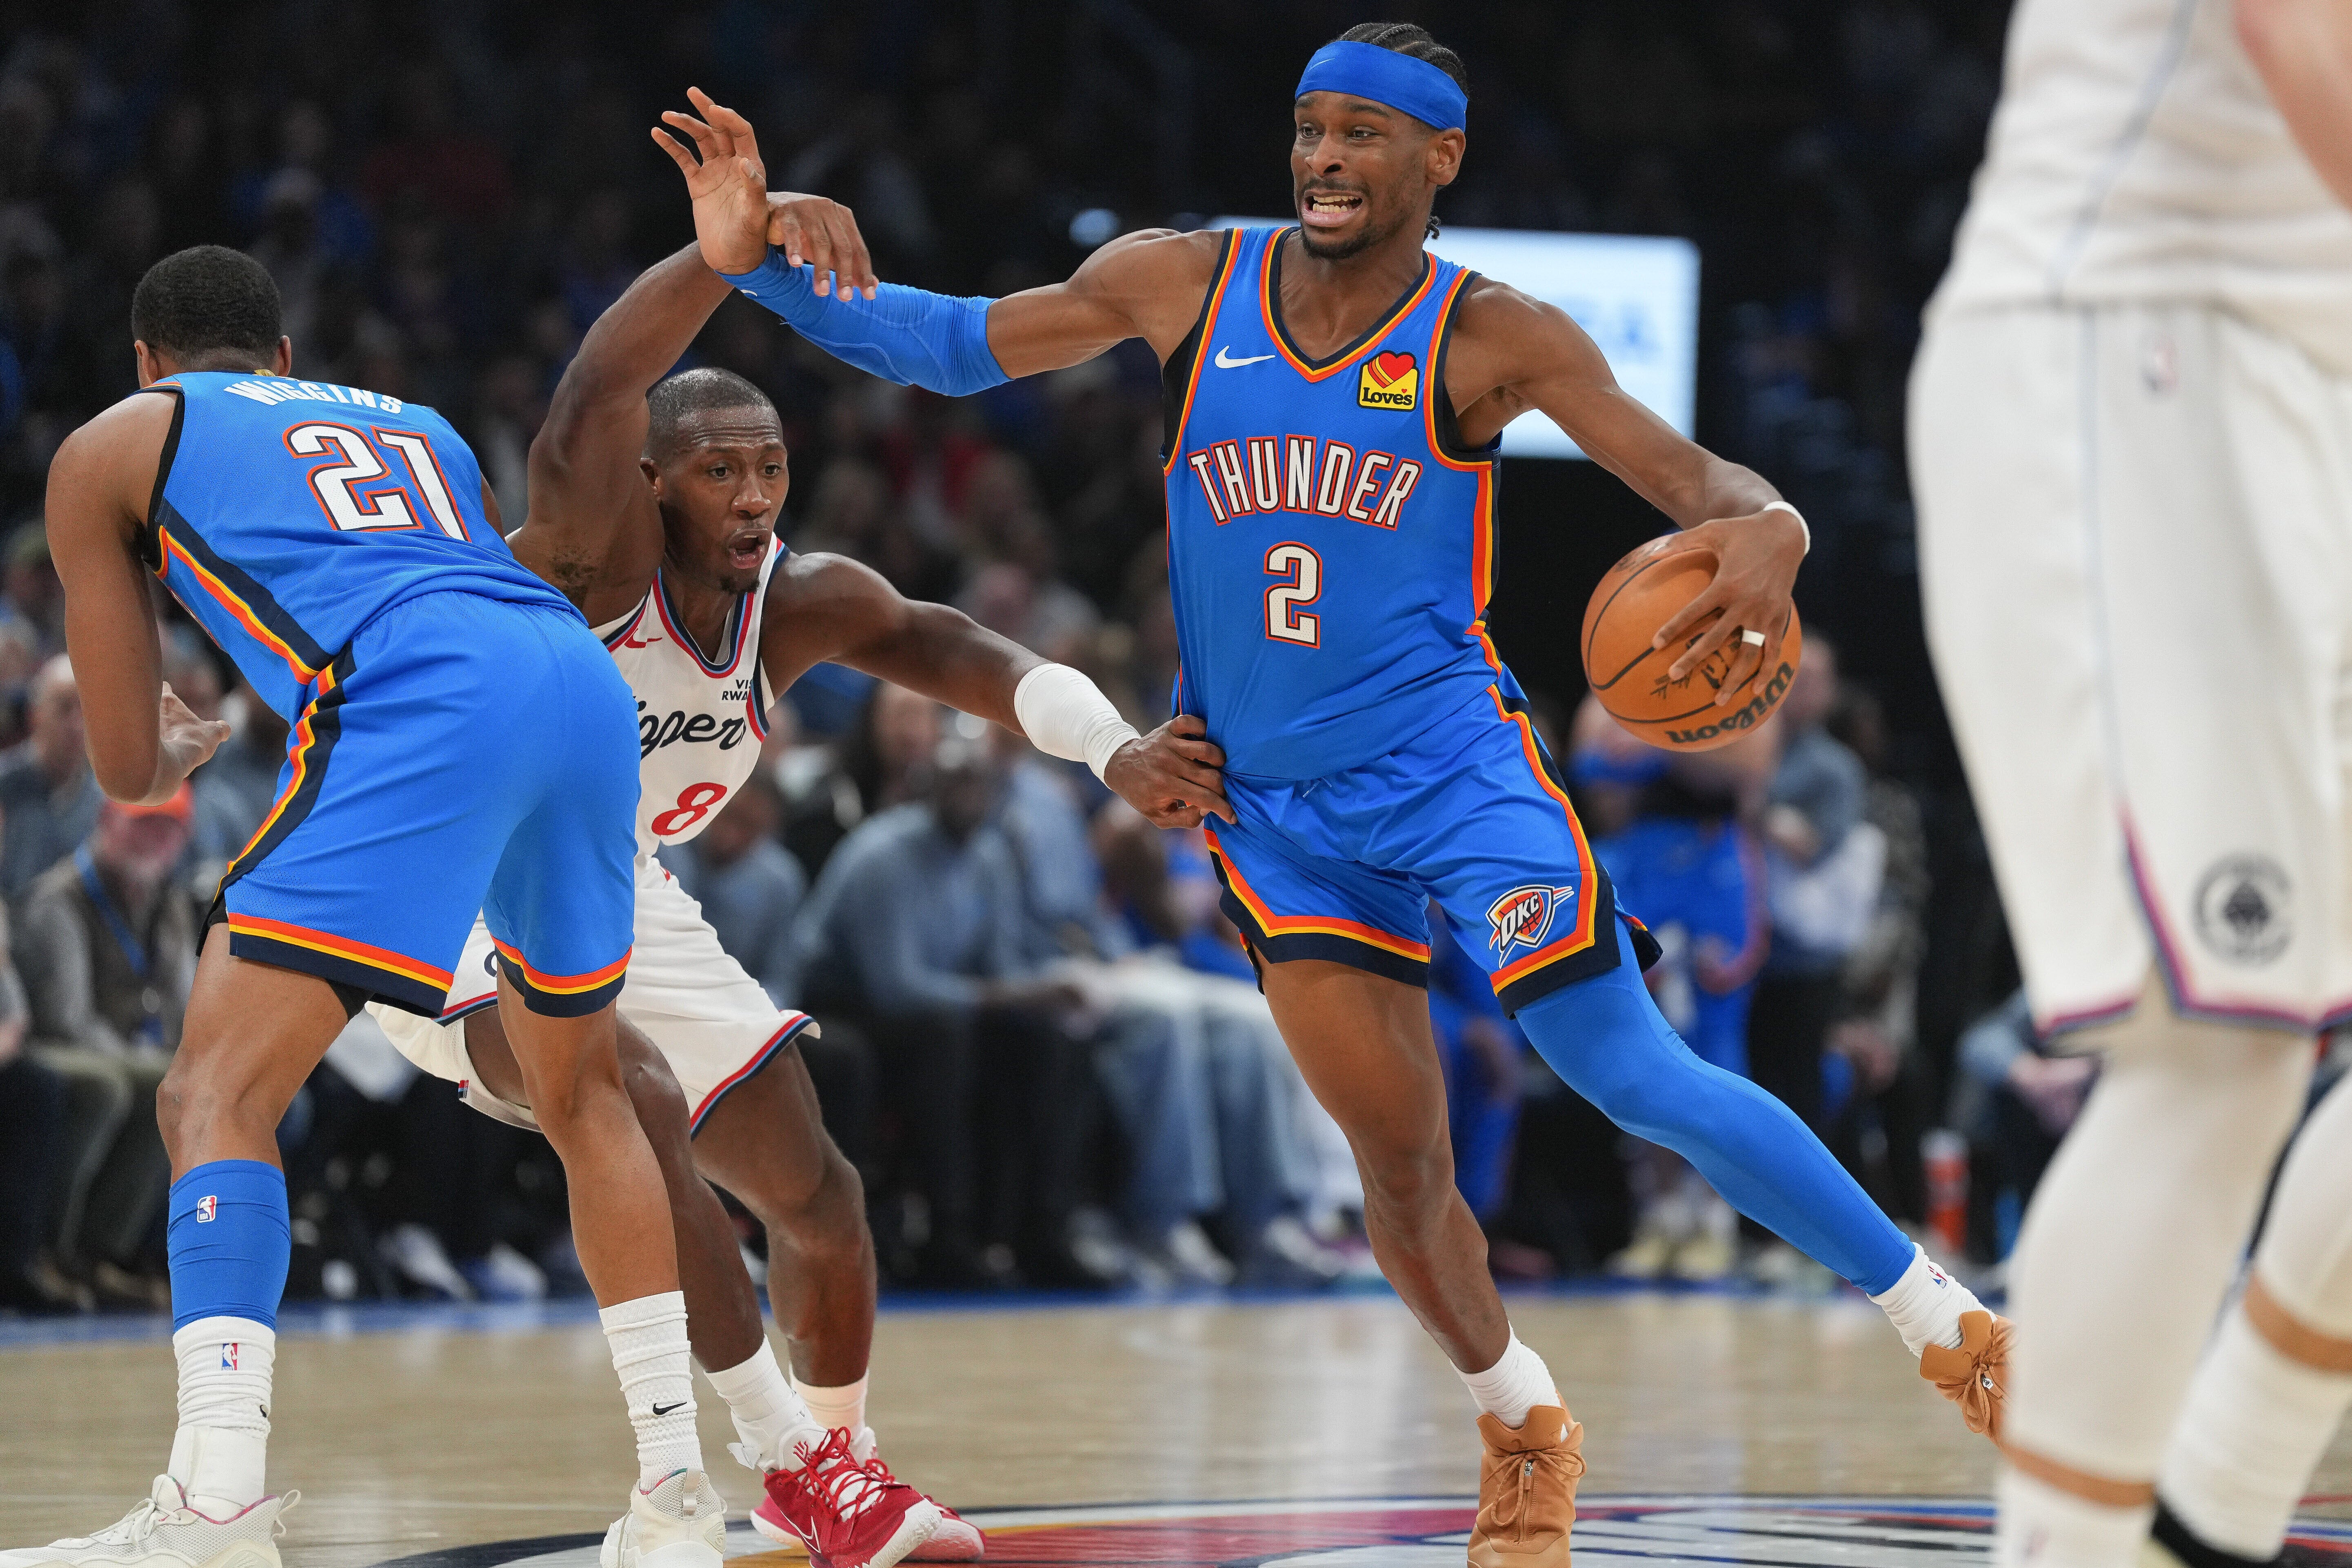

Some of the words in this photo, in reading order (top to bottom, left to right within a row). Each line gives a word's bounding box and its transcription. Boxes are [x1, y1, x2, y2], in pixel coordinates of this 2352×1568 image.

[223, 380, 402, 414] WIGGINS
[282, 420, 472, 542] 21
[1187, 434, 1423, 531] THUNDER
[1264, 541, 1322, 649] 2
[651, 782, 727, 835] 8
[1501, 893, 1539, 947] OKC
